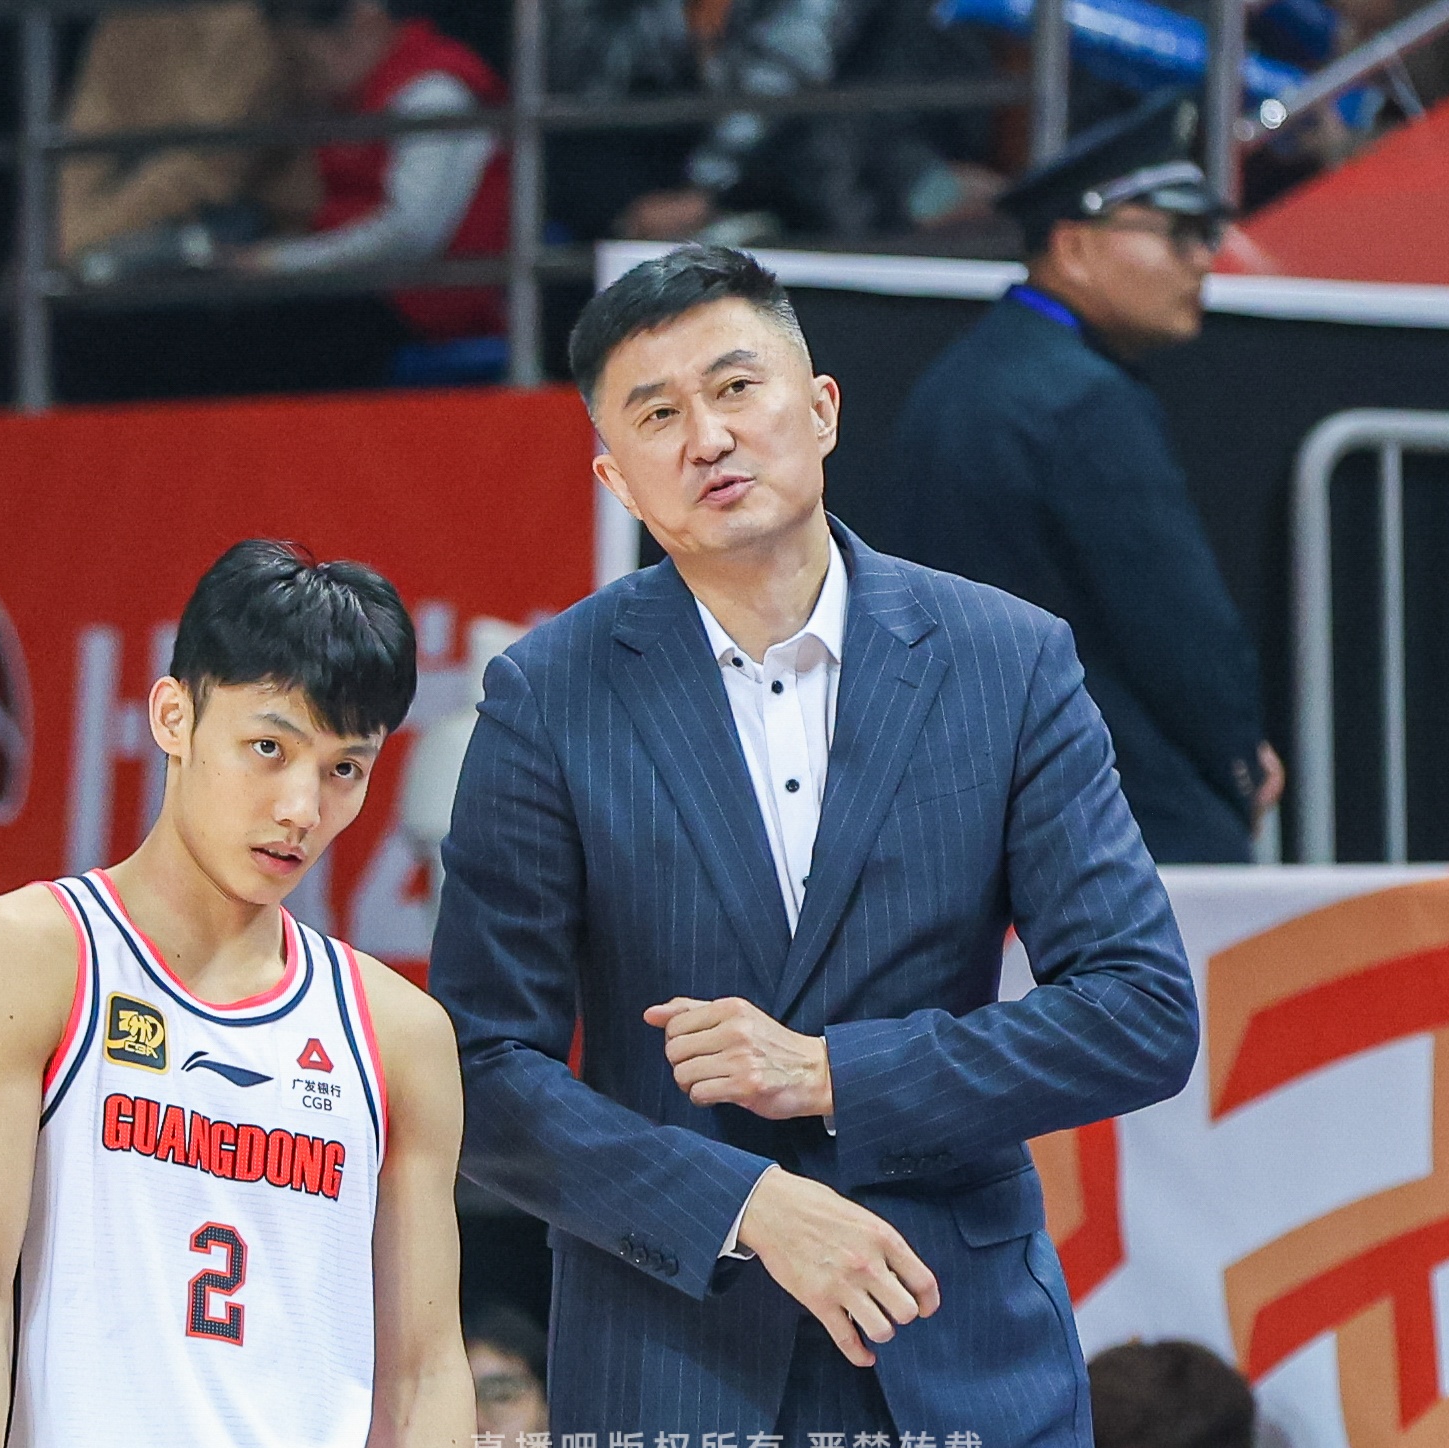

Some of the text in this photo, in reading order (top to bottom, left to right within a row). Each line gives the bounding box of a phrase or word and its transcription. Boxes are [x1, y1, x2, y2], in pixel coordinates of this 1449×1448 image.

[123, 1040, 159, 1059] CBA
[292, 1079, 342, 1098] 广发银行
[302, 1095, 333, 1112] CGB
[102, 1092, 346, 1201] GUANGDONG
[185, 1220, 248, 1347] 2
